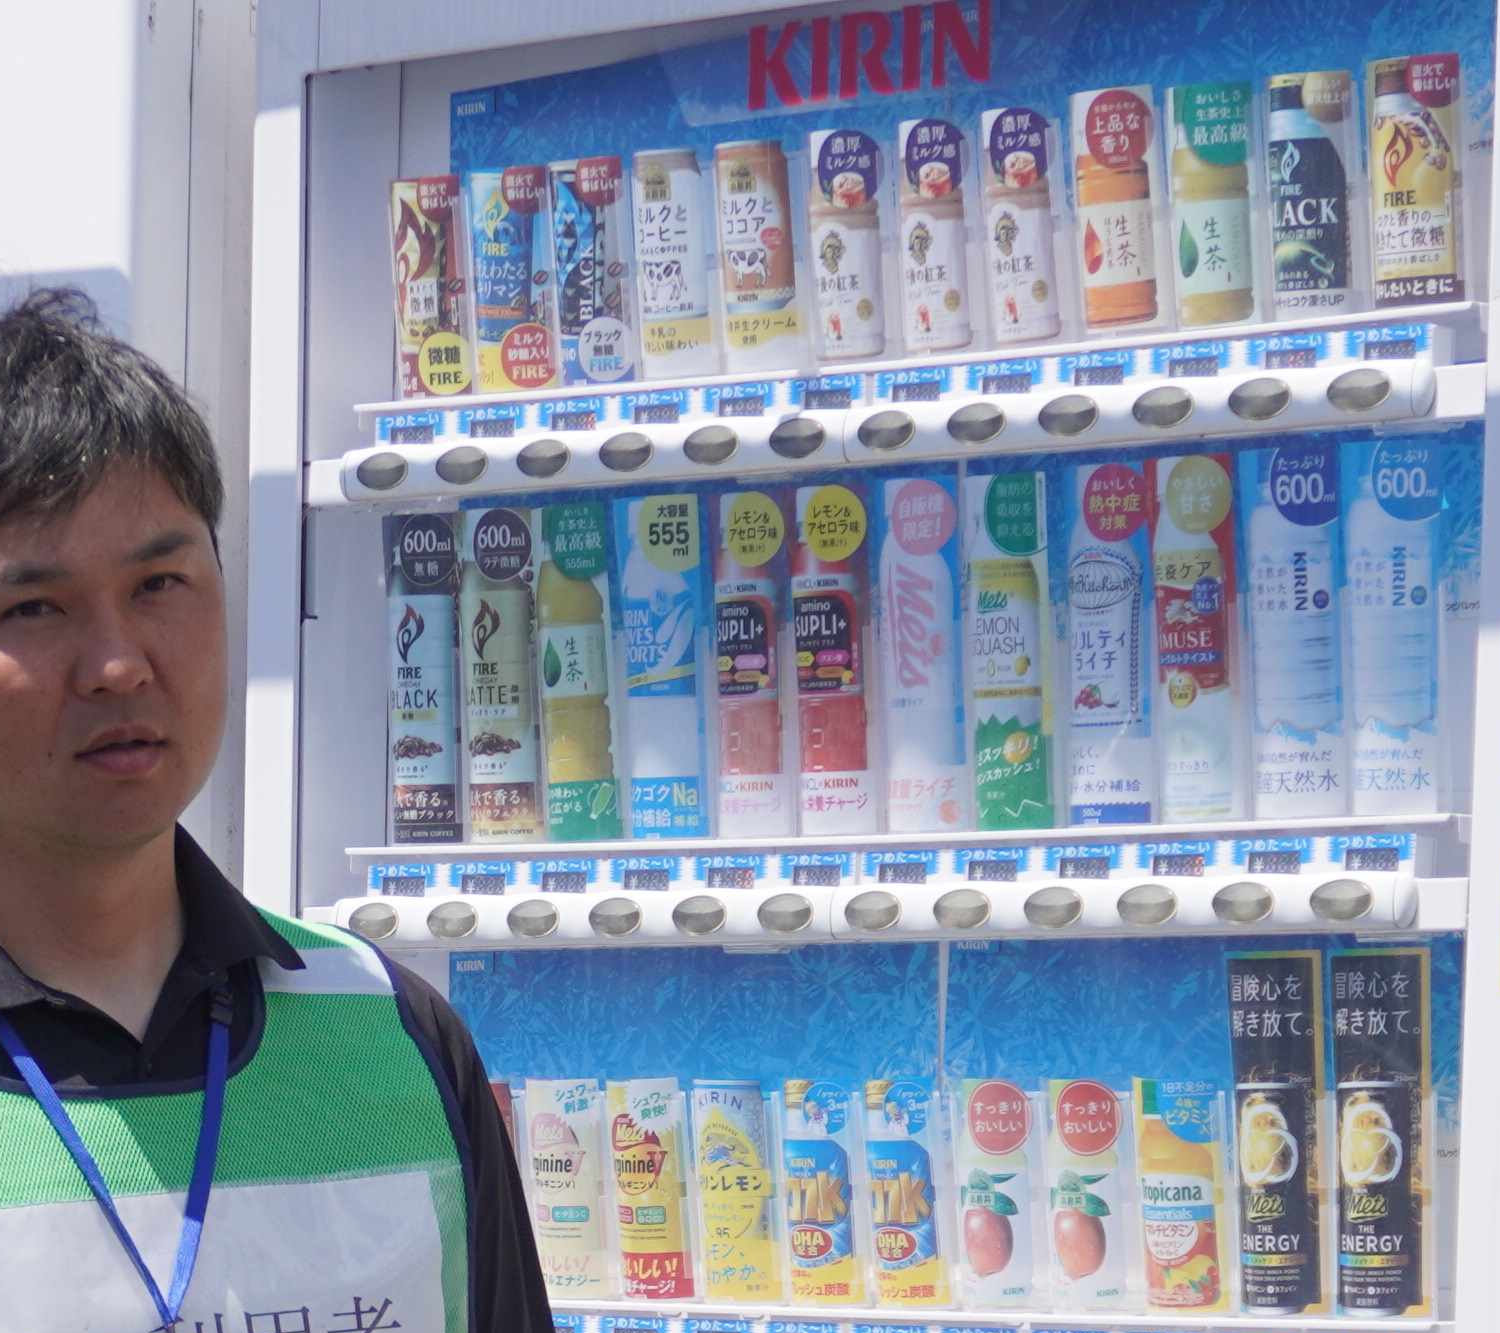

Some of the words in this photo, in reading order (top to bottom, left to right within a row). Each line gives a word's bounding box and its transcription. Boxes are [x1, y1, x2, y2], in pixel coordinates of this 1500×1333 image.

[748, 0, 991, 111] KIRIN
[457, 101, 486, 117] KIRIN
[1092, 113, 1141, 135] 上品な
[1100, 135, 1130, 154] 香り
[1383, 190, 1416, 208] FIRE
[482, 242, 509, 257] FIRE
[580, 247, 594, 321] BLACK
[428, 346, 461, 366] 微糖
[589, 356, 623, 372] FIRE
[429, 371, 463, 386] FIRE
[512, 364, 549, 380] FIRE
[657, 504, 688, 518] 大容量
[1090, 494, 1140, 514] 熱中症
[478, 525, 525, 548] 600ml
[650, 521, 690, 546] 555
[729, 526, 779, 541] アセロラ味
[808, 520, 861, 536] アセロラ味
[404, 529, 451, 553] 600ml
[673, 546, 689, 557] ml
[1294, 552, 1308, 611] KIRIN
[1392, 546, 1406, 606] KIRIN
[397, 667, 422, 679] FIRE
[456, 960, 485, 973] KIRIN
[1231, 973, 1302, 1002] 冒険心を
[1335, 971, 1409, 1000] 冒険心を
[1232, 1010, 1314, 1038] 解き放て。
[1336, 1008, 1421, 1036] 解き放て。
[974, 1101, 1022, 1116] すっきり
[1062, 1101, 1111, 1116] すっきり
[975, 1120, 1023, 1132] おいしい
[1064, 1120, 1112, 1133] おいしい
[1142, 1177, 1202, 1206] Tropicana
[1248, 1194, 1285, 1218] Mets
[1348, 1194, 1389, 1218] Mets
[1257, 1225, 1274, 1233] THE
[1358, 1225, 1376, 1234] THE
[794, 1232, 825, 1246] DHA
[877, 1234, 909, 1248] DHA
[1243, 1234, 1301, 1252] ENERGY
[1342, 1234, 1403, 1253] ENERGY
